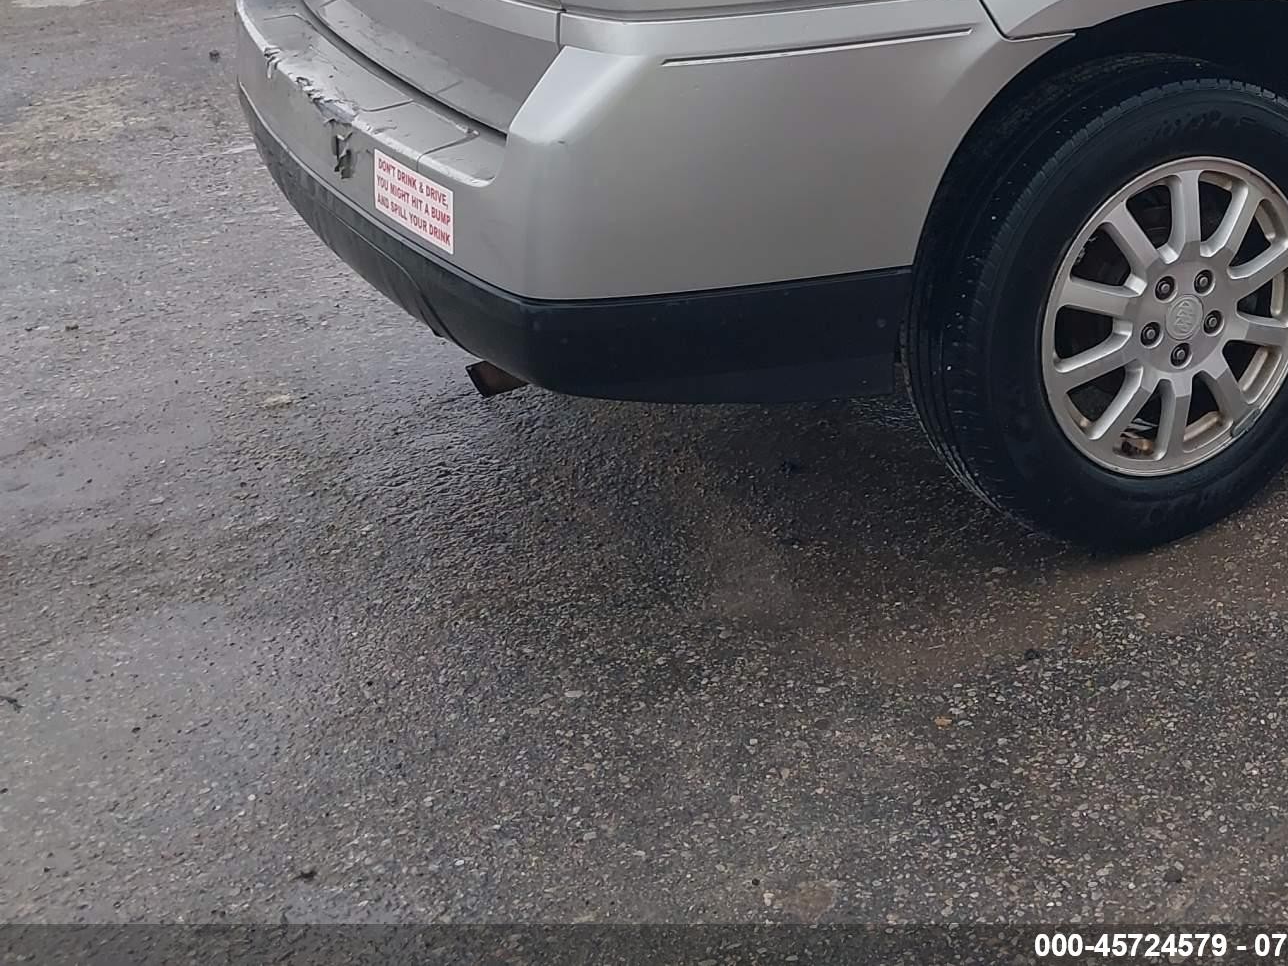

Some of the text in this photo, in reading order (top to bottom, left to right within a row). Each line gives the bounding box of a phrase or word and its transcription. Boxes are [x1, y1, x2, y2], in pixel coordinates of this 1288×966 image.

[377, 175, 451, 227] YOU MIGHT HIT A BUMP
[379, 158, 395, 176] DON'T
[397, 169, 417, 190] DRINK
[419, 182, 424, 194] &
[377, 193, 450, 246] AND SPILL YOUR DRINK
